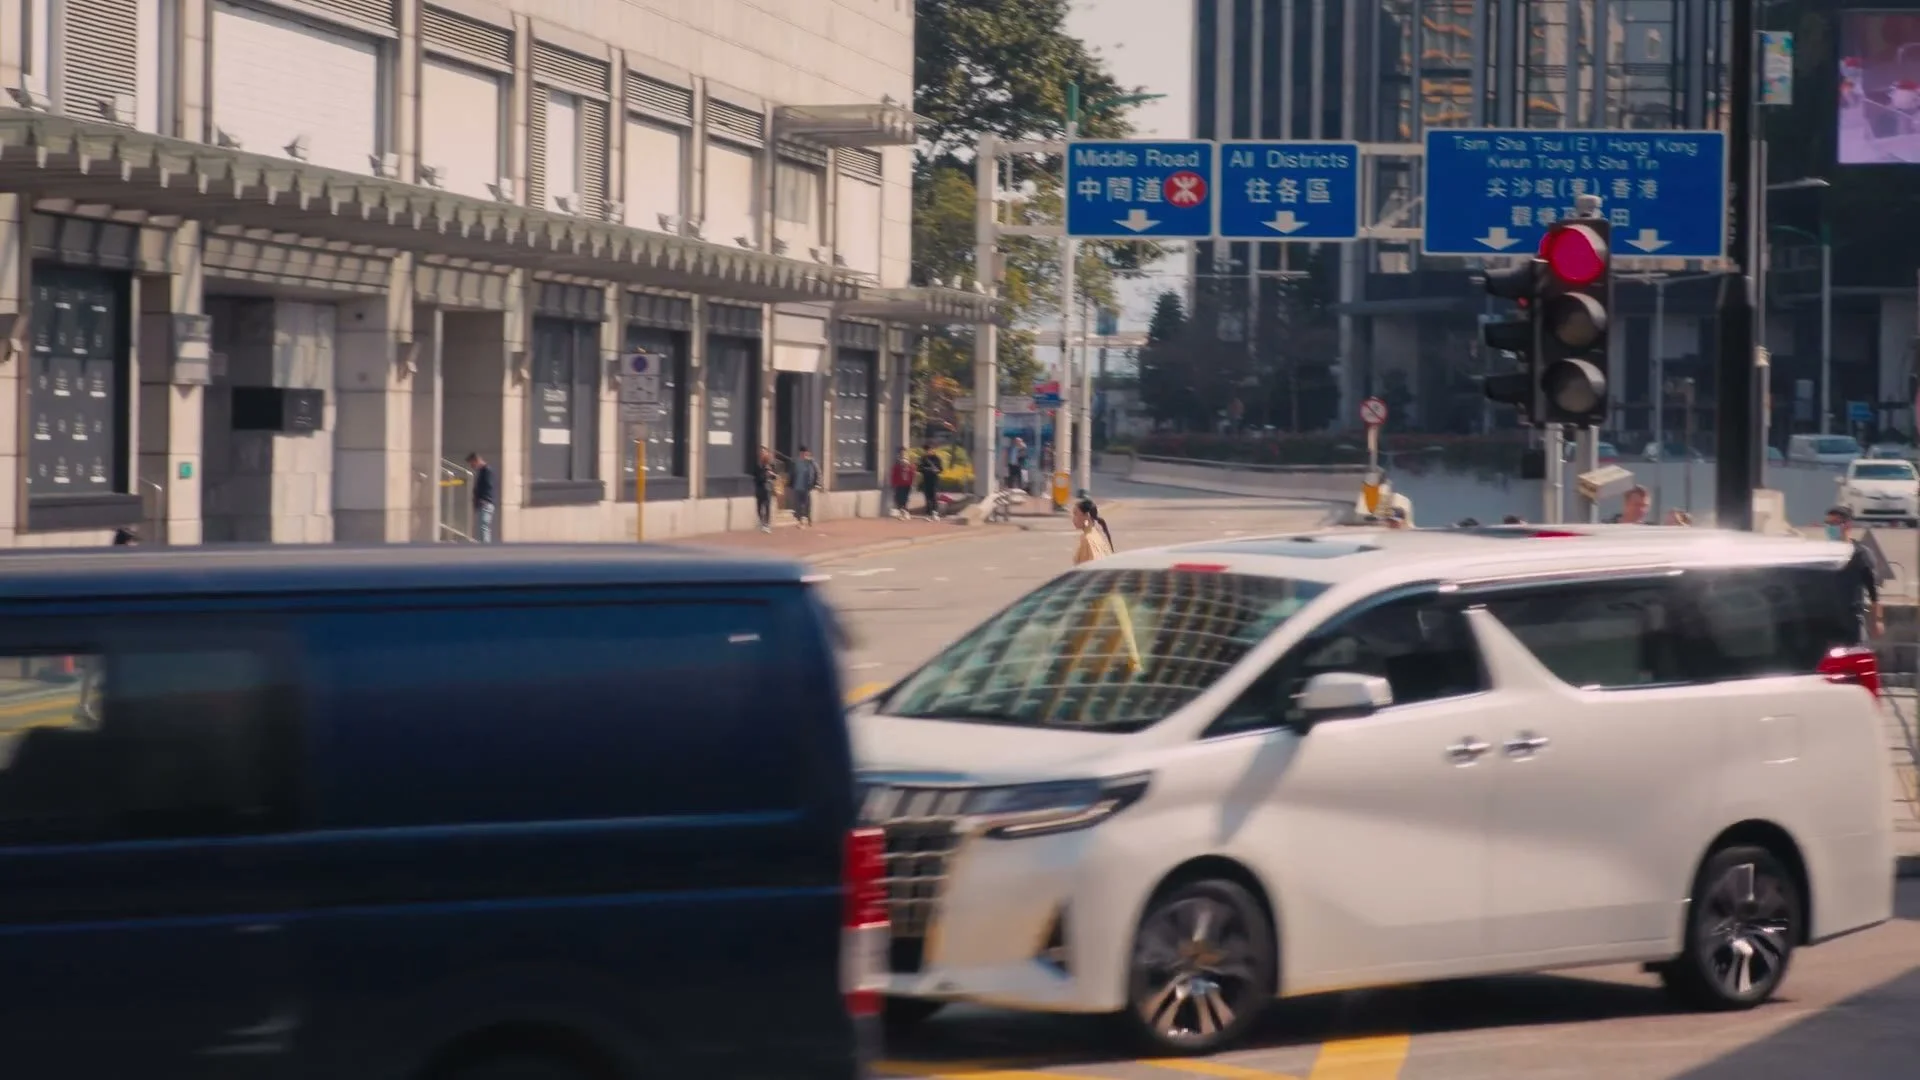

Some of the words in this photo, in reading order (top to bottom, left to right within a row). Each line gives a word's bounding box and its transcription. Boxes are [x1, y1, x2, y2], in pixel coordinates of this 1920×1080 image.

[1452, 135, 1489, 151] Tsim
[1496, 136, 1527, 151] Sha
[1532, 136, 1564, 152] Tsui
[1607, 138, 1649, 155] Hong
[1655, 139, 1698, 156] Kong
[1075, 149, 1138, 167] Middle
[1145, 149, 1200, 167] Road
[1228, 150, 1254, 168] All
[1266, 150, 1349, 168] Districts
[1487, 156, 1532, 168] Kwun
[1536, 154, 1575, 173] Tong
[1580, 155, 1593, 170] &
[1597, 155, 1630, 170] Sha
[1634, 155, 1659, 170] Tin
[1077, 176, 1163, 202] 中間道
[1244, 177, 1332, 203] 往各區
[1511, 206, 1630, 227] 觀塘田
